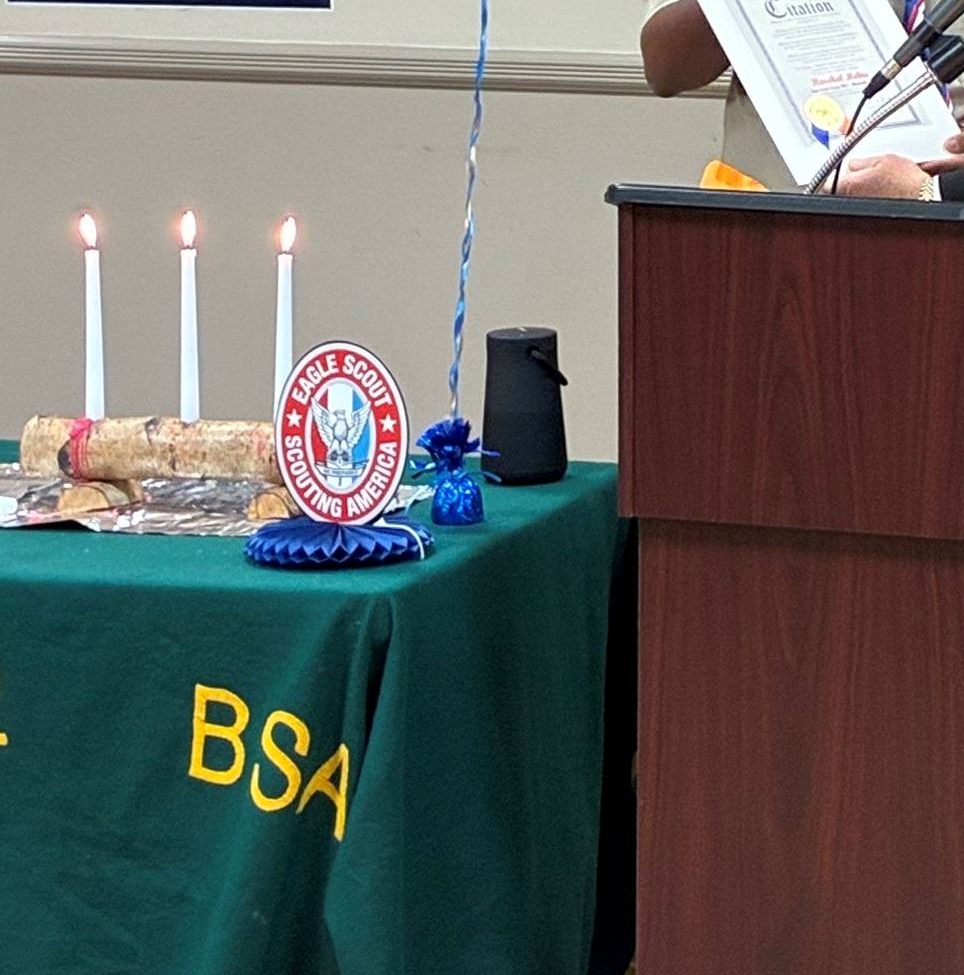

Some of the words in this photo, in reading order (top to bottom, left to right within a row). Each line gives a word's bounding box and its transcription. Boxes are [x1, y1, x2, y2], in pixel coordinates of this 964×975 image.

[291, 353, 340, 406] EAGLE
[342, 354, 393, 407] SCOUT
[285, 434, 343, 518] SCOUTING
[346, 441, 398, 517] AMERICA
[188, 683, 350, 843] BSA
